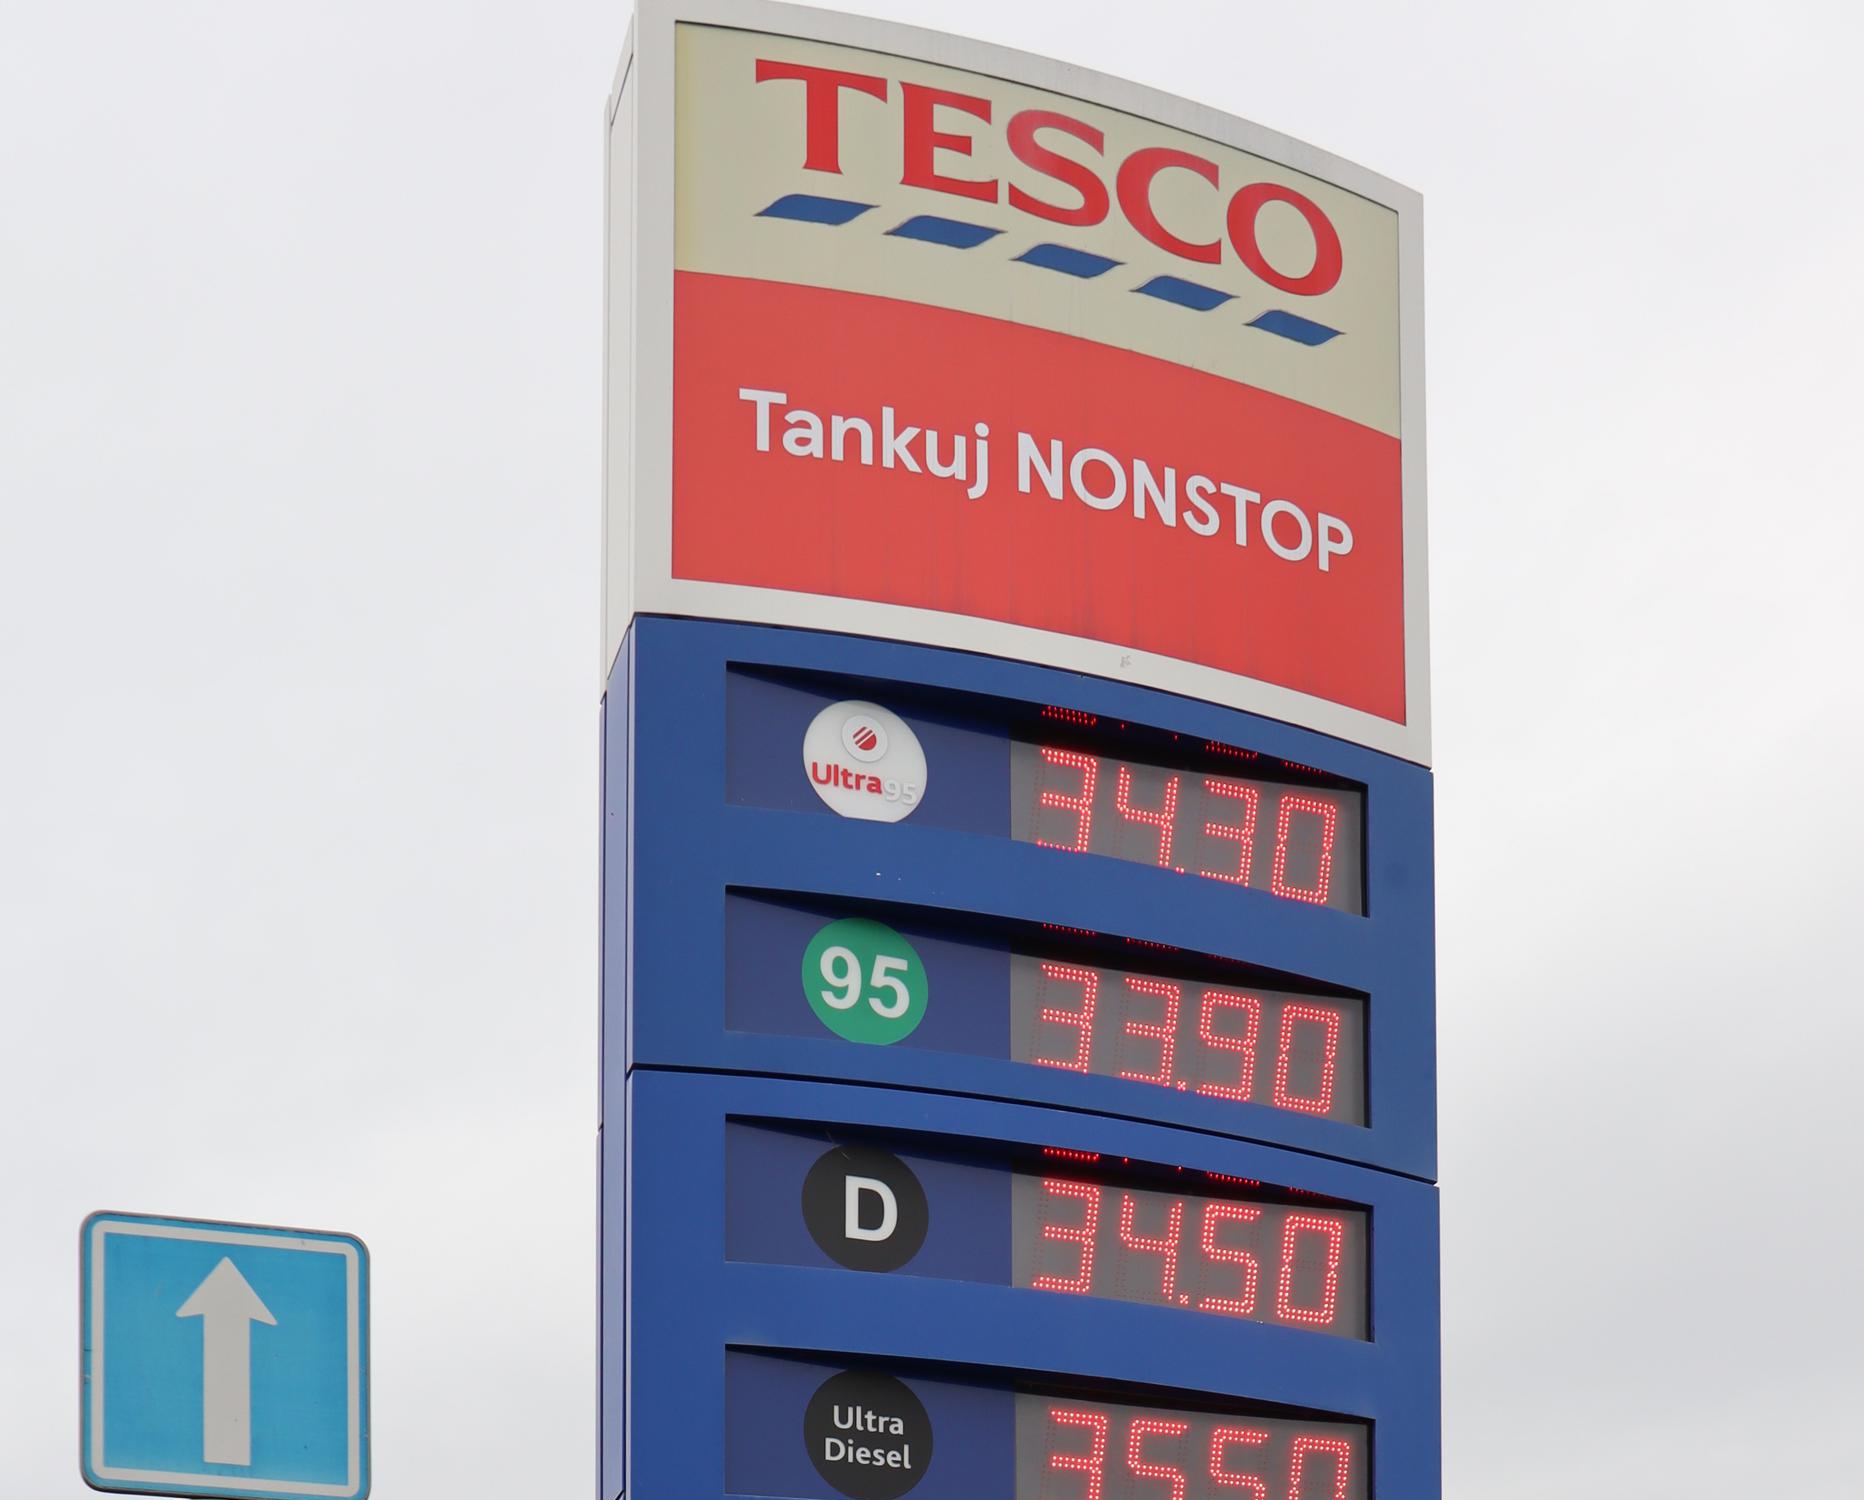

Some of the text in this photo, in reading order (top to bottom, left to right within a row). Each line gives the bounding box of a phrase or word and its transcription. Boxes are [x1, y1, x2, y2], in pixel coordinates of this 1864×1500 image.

[756, 58, 1343, 297] TESCO
[739, 387, 1354, 573] Tankuj NONSTOP
[1036, 746, 1338, 905] 34.30
[819, 945, 911, 1019] 95
[1035, 962, 1341, 1115] 33.90
[845, 1174, 898, 1242] D
[1032, 1179, 1344, 1325] 34.50
[825, 1437, 912, 1470] Diesel
[833, 1404, 904, 1436] Ultra
